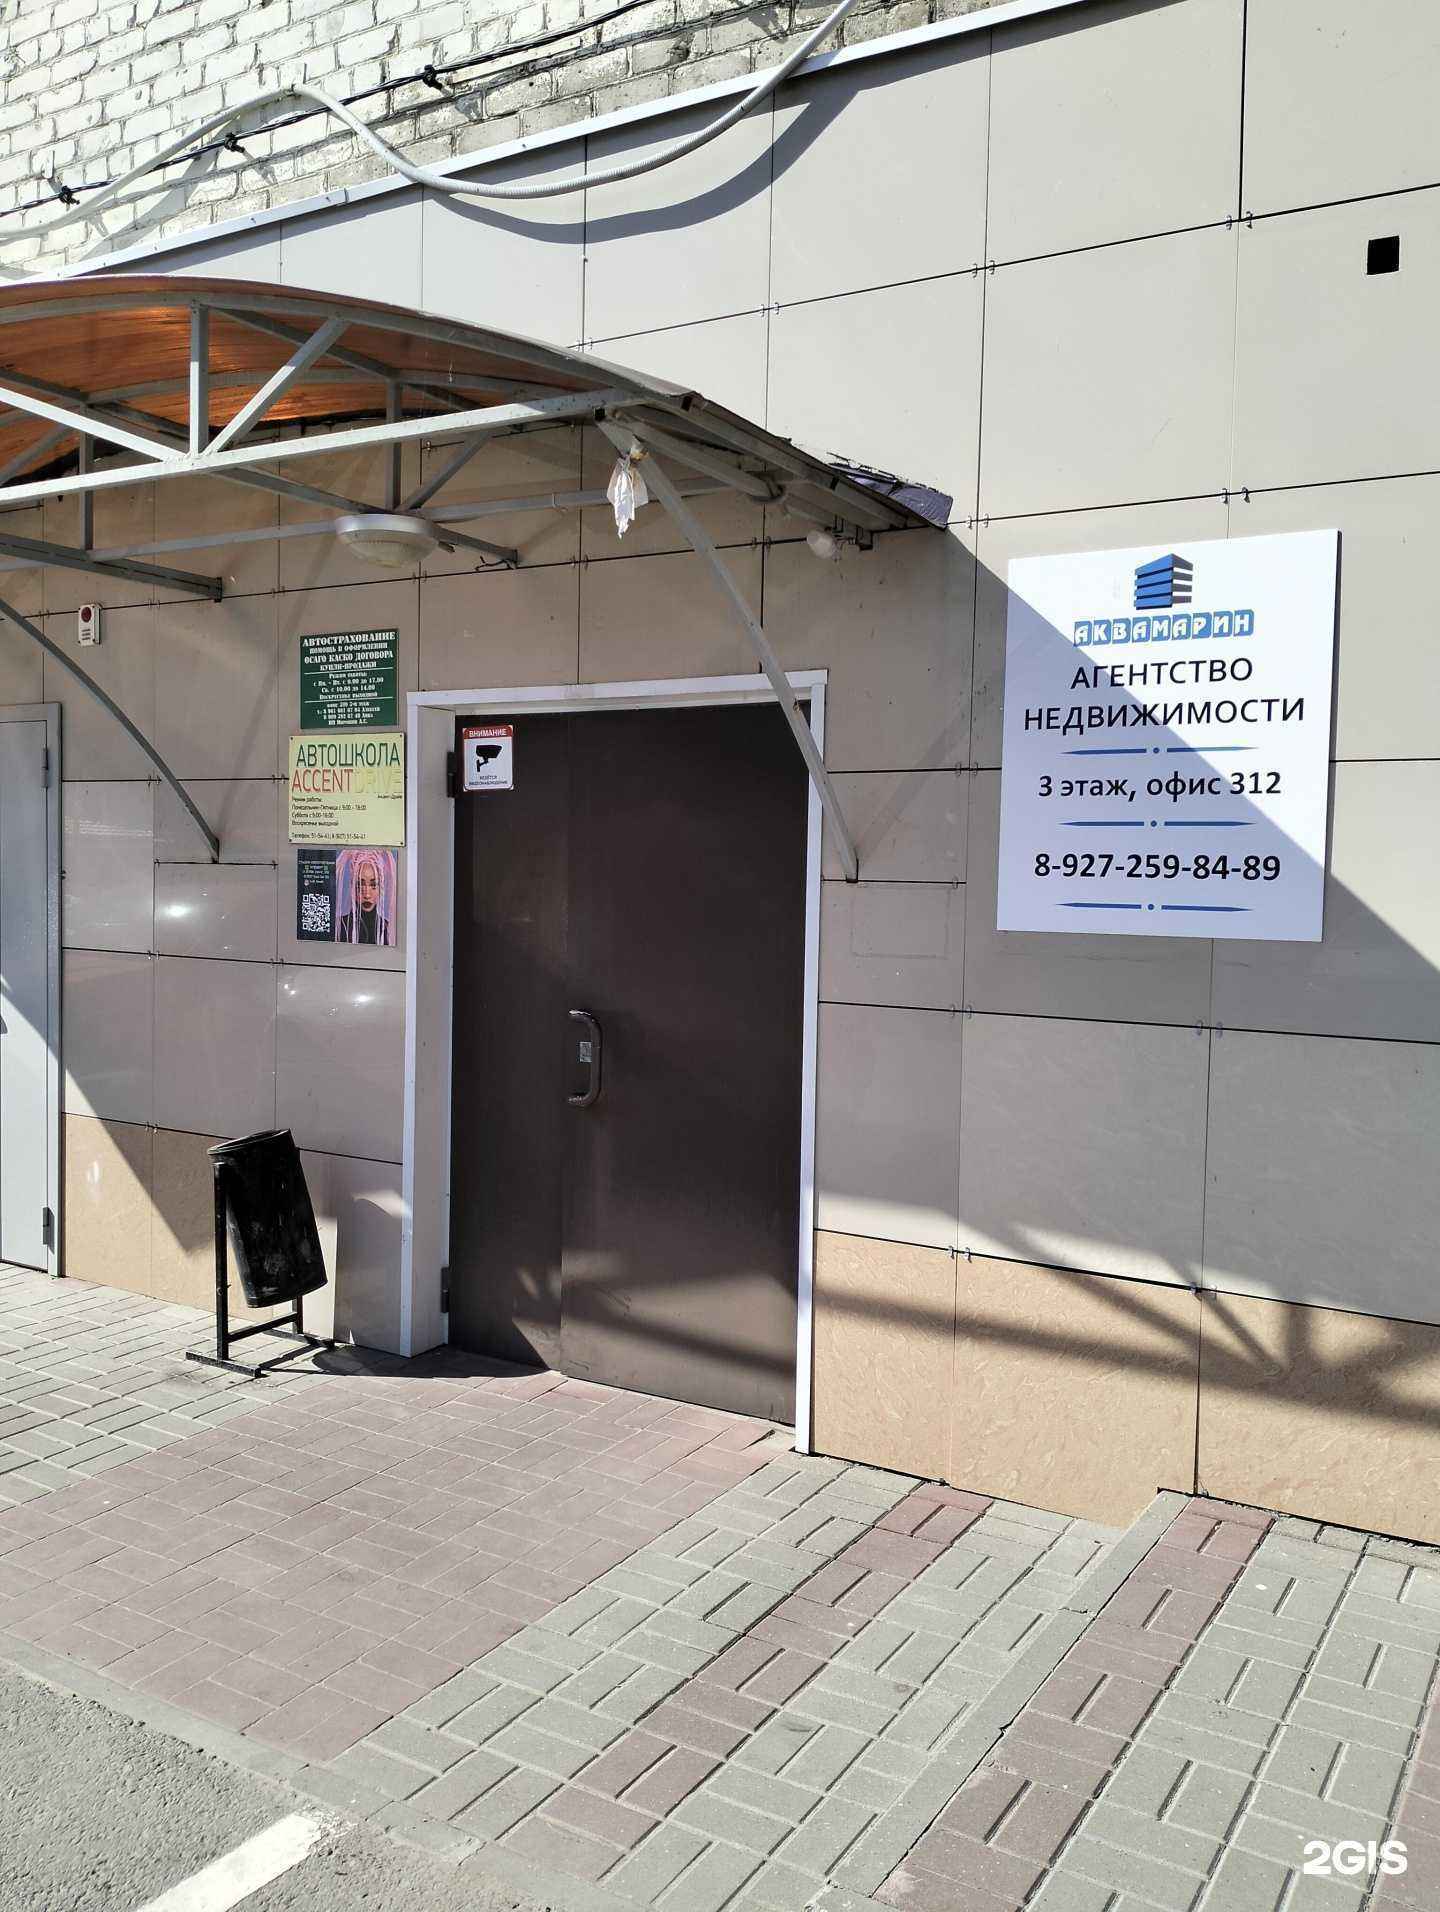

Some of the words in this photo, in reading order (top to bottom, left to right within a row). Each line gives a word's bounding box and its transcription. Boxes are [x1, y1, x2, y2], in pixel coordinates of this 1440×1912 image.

[303, 632, 395, 647] АВТОСТРАХОВАНИЕ
[1074, 609, 1253, 646] АКВАМАРИН
[304, 656, 326, 664] ОСАГО
[329, 653, 353, 662] КАСКО
[355, 650, 394, 661] ДОГОВОРА
[1071, 657, 1252, 690] АГЕНТСТВО
[1024, 697, 1305, 736] НЕДВИЖИМОСТИ
[469, 728, 508, 738] ВНИМАНИЕ
[296, 743, 400, 767] АВТОШКОЛА
[1039, 776, 1052, 797] 3
[1060, 778, 1137, 802] этаж,
[1146, 771, 1221, 802] офис
[1230, 771, 1282, 796] 312
[1034, 853, 1281, 881] 8-927-259-84-89
